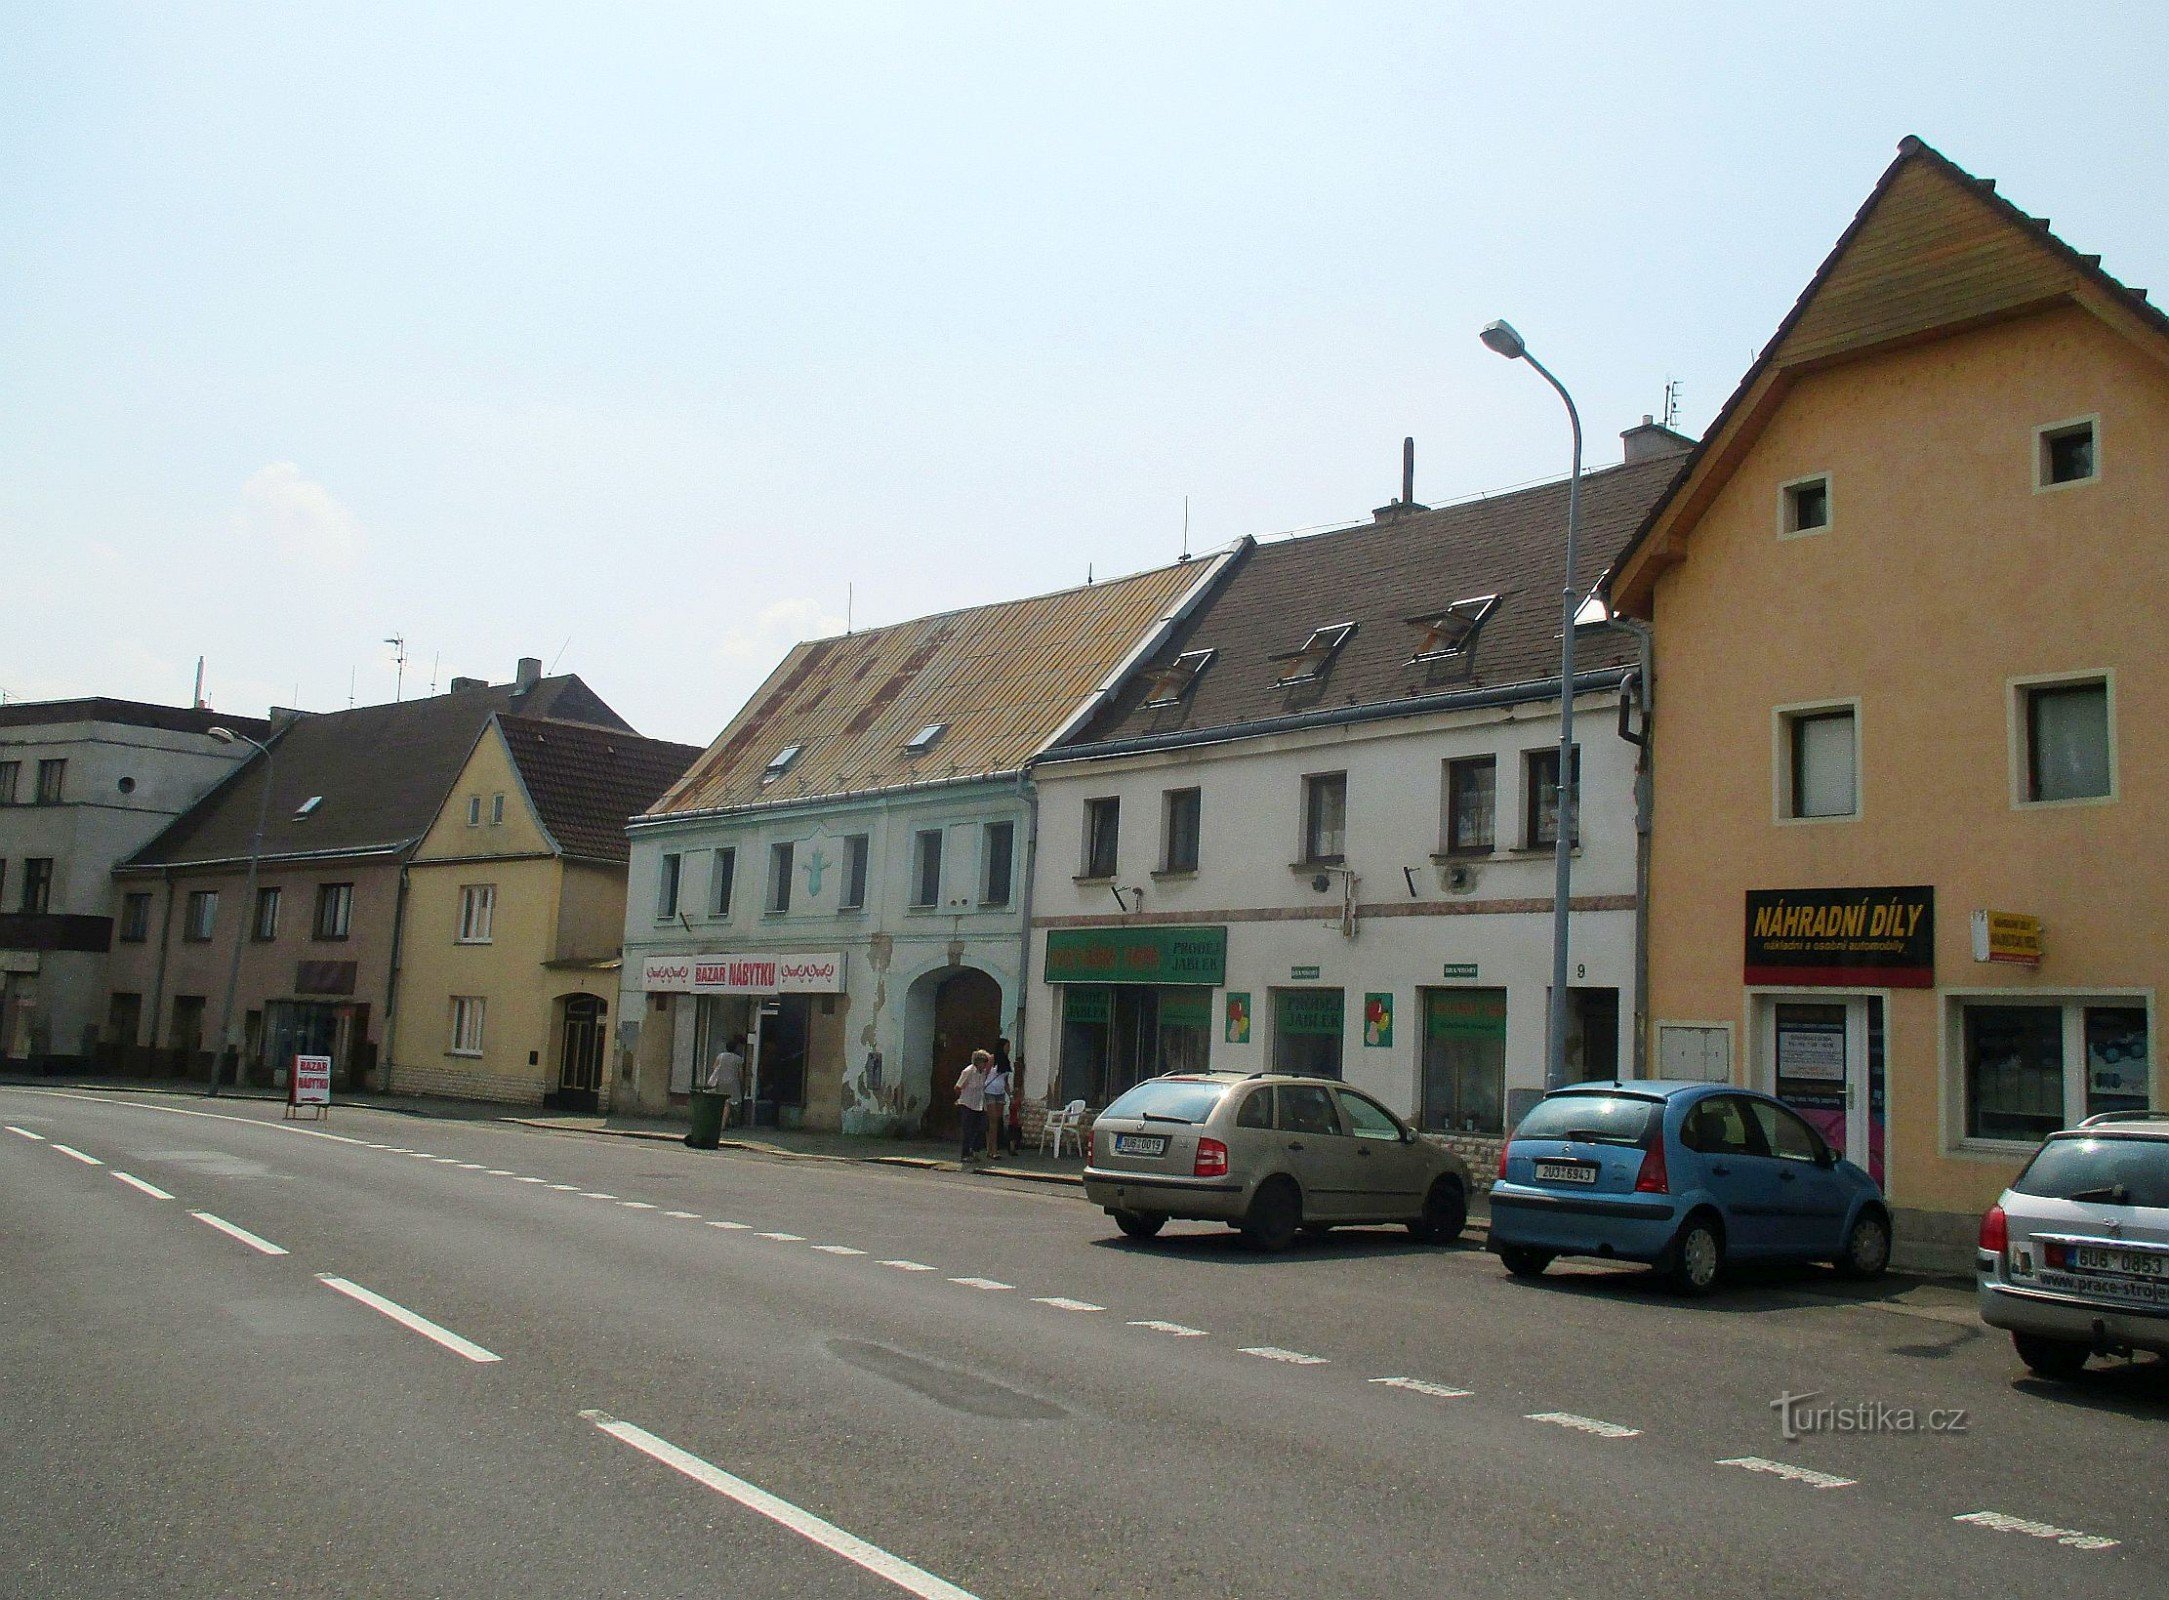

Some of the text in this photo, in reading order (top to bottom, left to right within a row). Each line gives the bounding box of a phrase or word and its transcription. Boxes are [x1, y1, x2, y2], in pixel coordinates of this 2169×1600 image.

[1753, 896, 1924, 937] NÁHRADNÍ DÍLY
[1172, 941, 1221, 955] PRODEJ
[1763, 939, 1803, 951] nákladní
[1848, 940, 1905, 953] automobily
[1171, 956, 1218, 971] JABLEK
[694, 959, 776, 986] BAZAR NÁBYTKU
[1577, 964, 1586, 979] 9
[300, 1061, 328, 1072] BAZAR
[1542, 1165, 1560, 1178] 2U3
[2079, 1249, 2163, 1275] 6U6 0853
